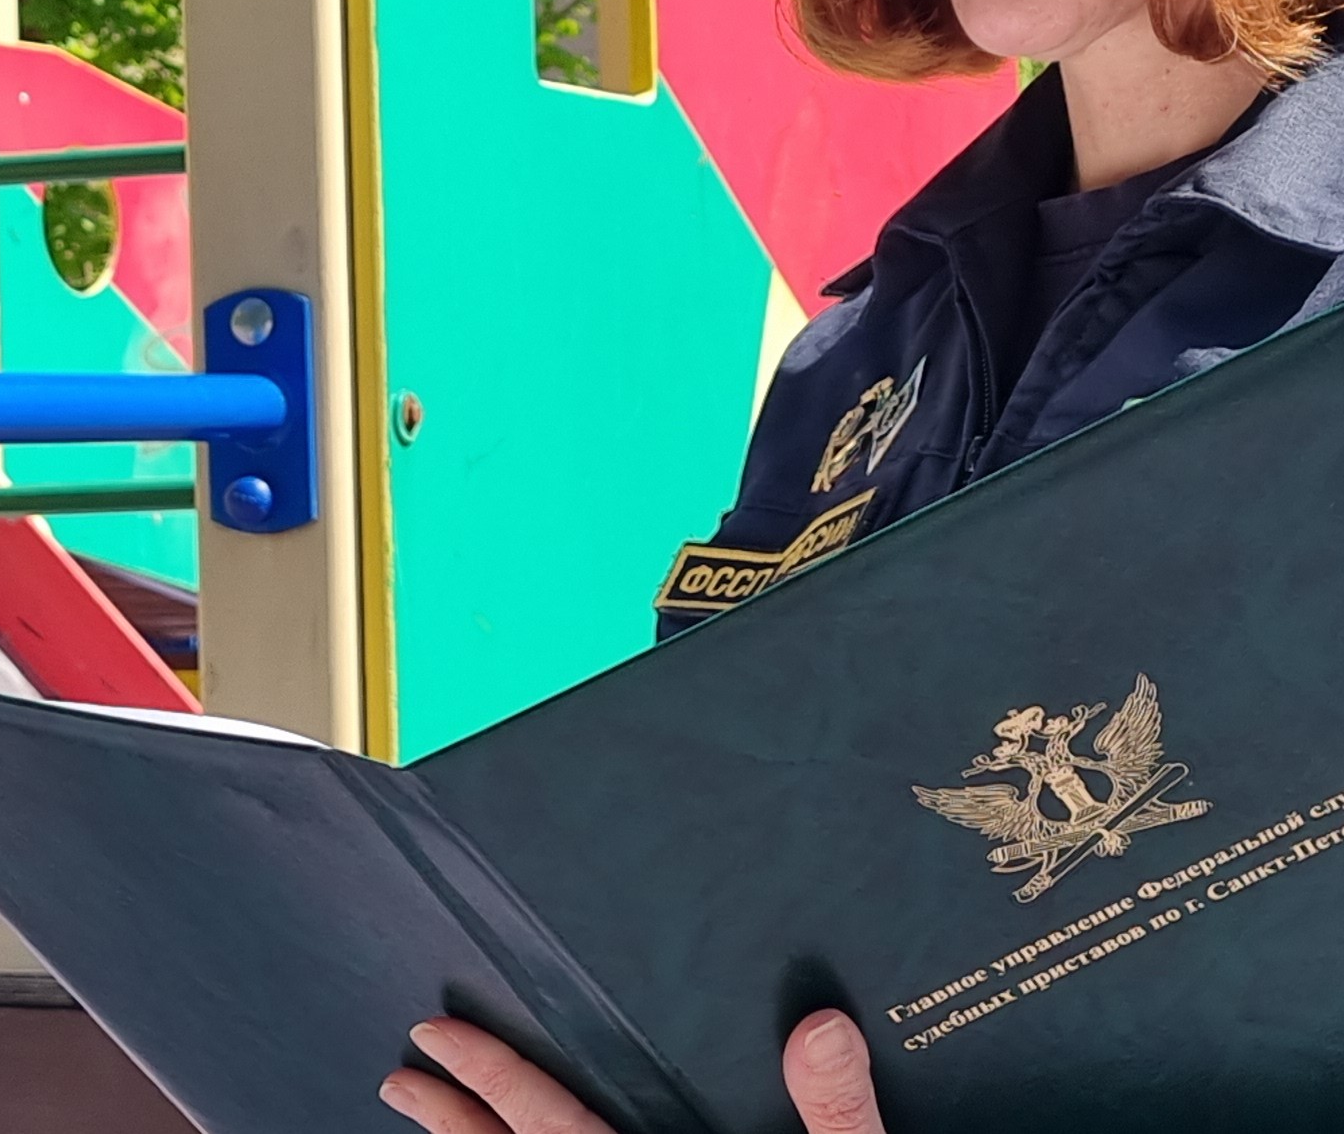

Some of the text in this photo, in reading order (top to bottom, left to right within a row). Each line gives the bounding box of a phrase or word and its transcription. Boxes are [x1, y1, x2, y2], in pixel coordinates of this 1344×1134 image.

[678, 510, 859, 598] ФССП ССИИ
[885, 967, 989, 1024] Главное
[989, 897, 1135, 977] управление
[1136, 811, 1305, 899] Федеральной
[903, 988, 1018, 1052] судебных
[1016, 925, 1147, 995] приставов
[1148, 908, 1182, 931] по
[1184, 898, 1206, 915] г.
